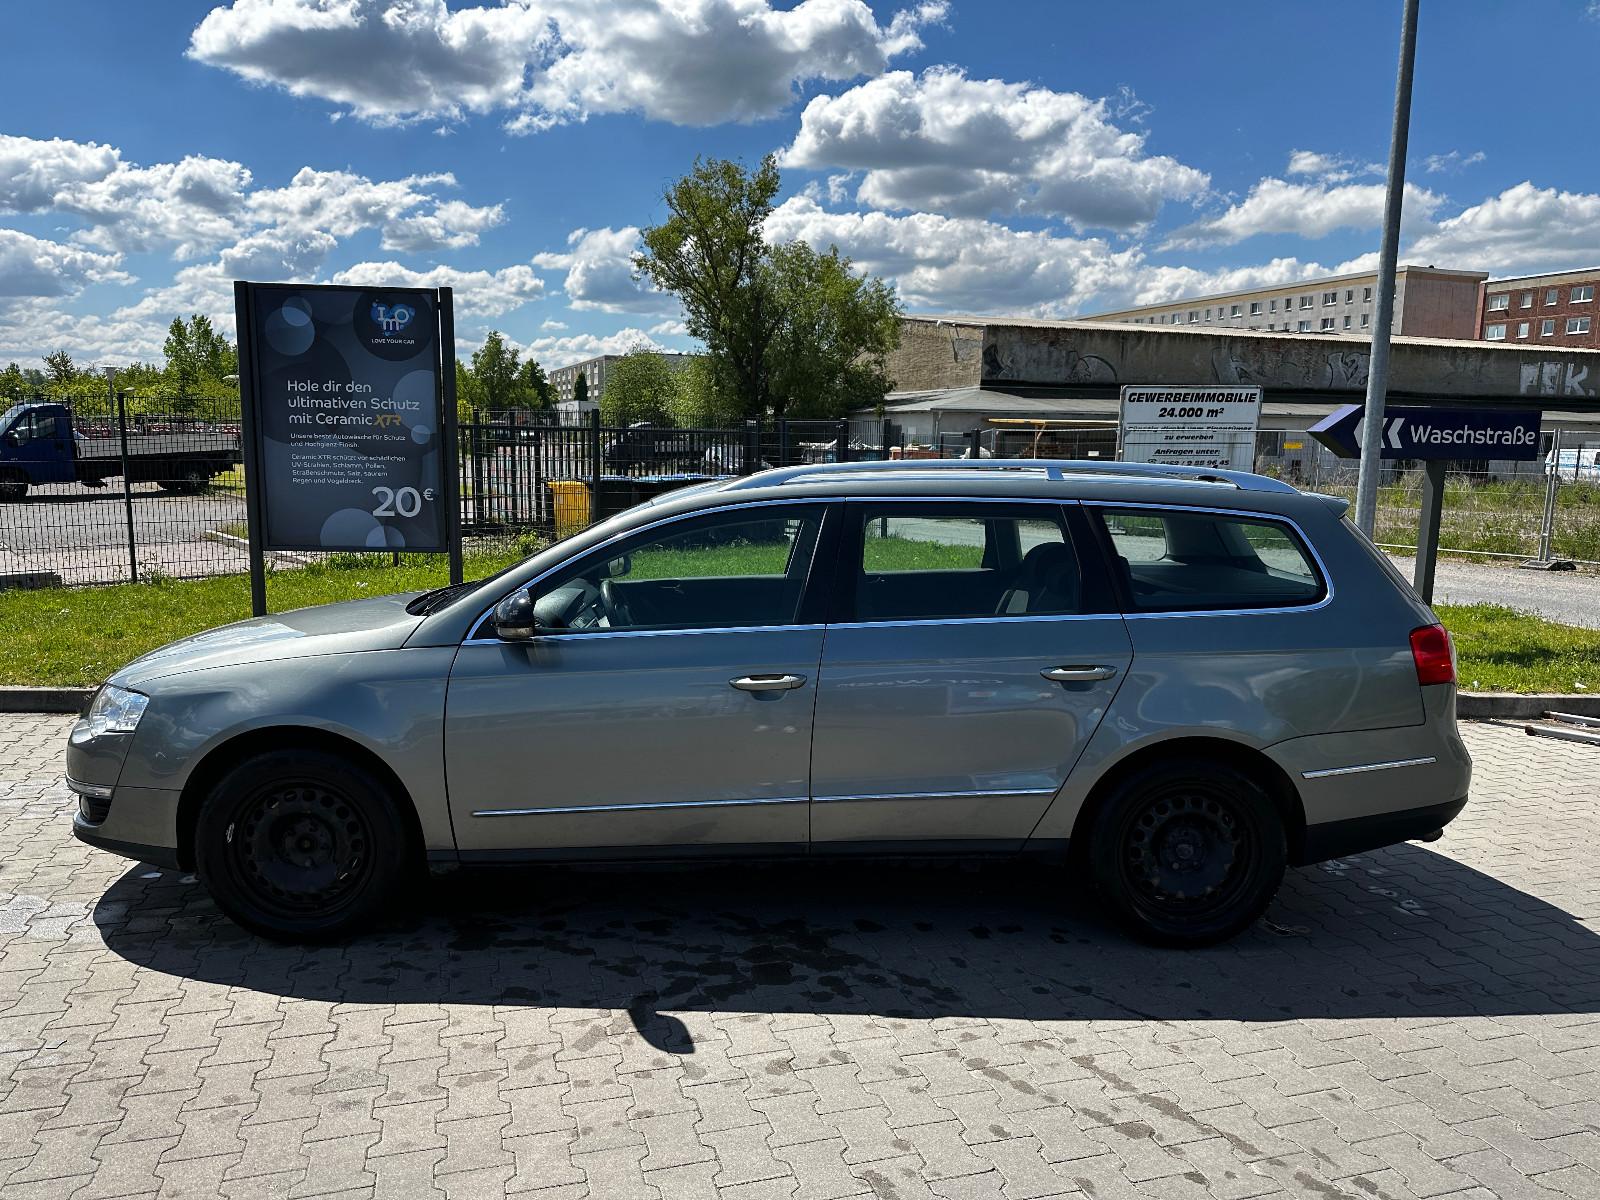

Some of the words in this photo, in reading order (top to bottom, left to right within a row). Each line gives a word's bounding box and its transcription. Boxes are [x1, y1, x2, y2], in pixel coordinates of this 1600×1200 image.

[287, 380, 319, 392] Hole
[322, 380, 342, 392] dir
[345, 381, 372, 393] den
[288, 396, 367, 409] ultimativen
[371, 397, 420, 410] Schutz
[1128, 392, 1258, 403] GEWERBEIMMOBILIE
[1158, 407, 1203, 418] 24.000
[1206, 407, 1225, 418] m²
[289, 412, 313, 424] mit
[316, 412, 373, 425] Ceramic
[373, 414, 402, 428] XTR
[1410, 424, 1536, 445] Waschstraße
[1154, 448, 1194, 456] Anfragen
[292, 477, 313, 485] Regen
